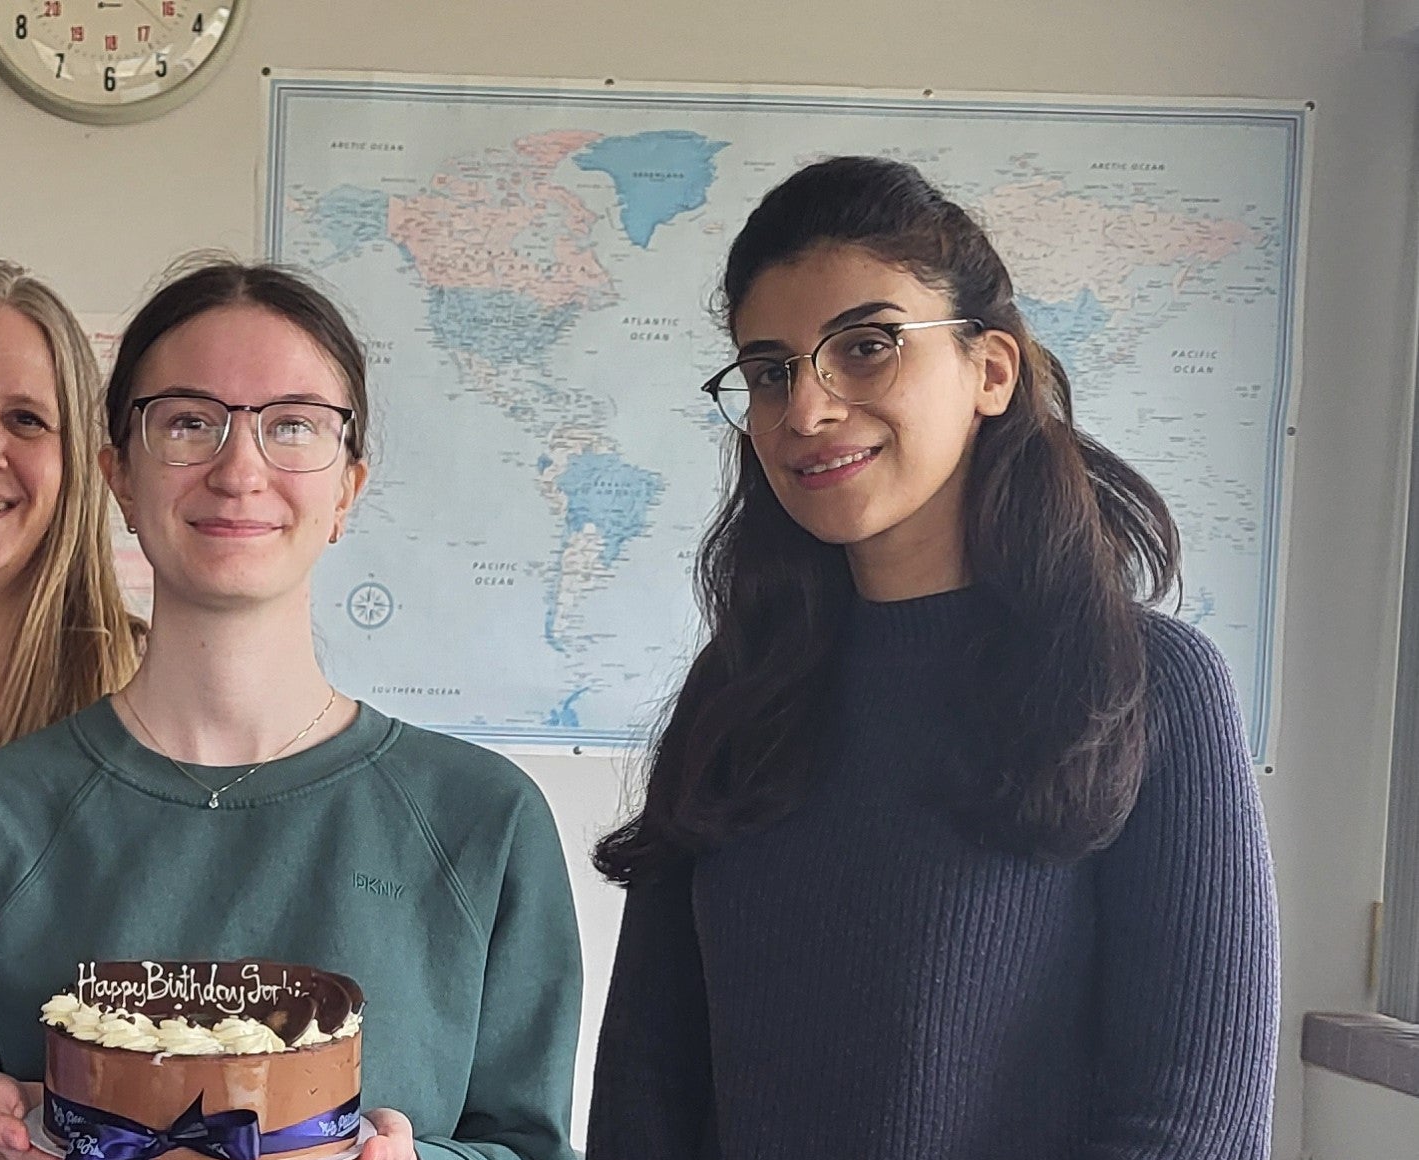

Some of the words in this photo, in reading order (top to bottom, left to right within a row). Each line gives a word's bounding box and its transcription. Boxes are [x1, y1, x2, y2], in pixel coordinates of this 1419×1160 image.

[162, 1, 175, 17] 16
[16, 14, 27, 39] 8
[191, 13, 203, 36] 4
[137, 25, 150, 42] 17
[55, 53, 64, 79] 7
[155, 52, 167, 77] 5
[104, 66, 116, 91] 6
[622, 317, 679, 326] ATLANTIC
[630, 332, 670, 341] OCEAN
[1171, 351, 1217, 359] PACIFIC
[1174, 365, 1214, 374] OCEAN
[472, 562, 518, 571] PACIFIC
[474, 577, 515, 586] OCEAN
[427, 687, 461, 695] OCEAN
[352, 872, 405, 899] DKNY
[78, 961, 146, 1008] Happy
[142, 961, 245, 1014] Birthday
